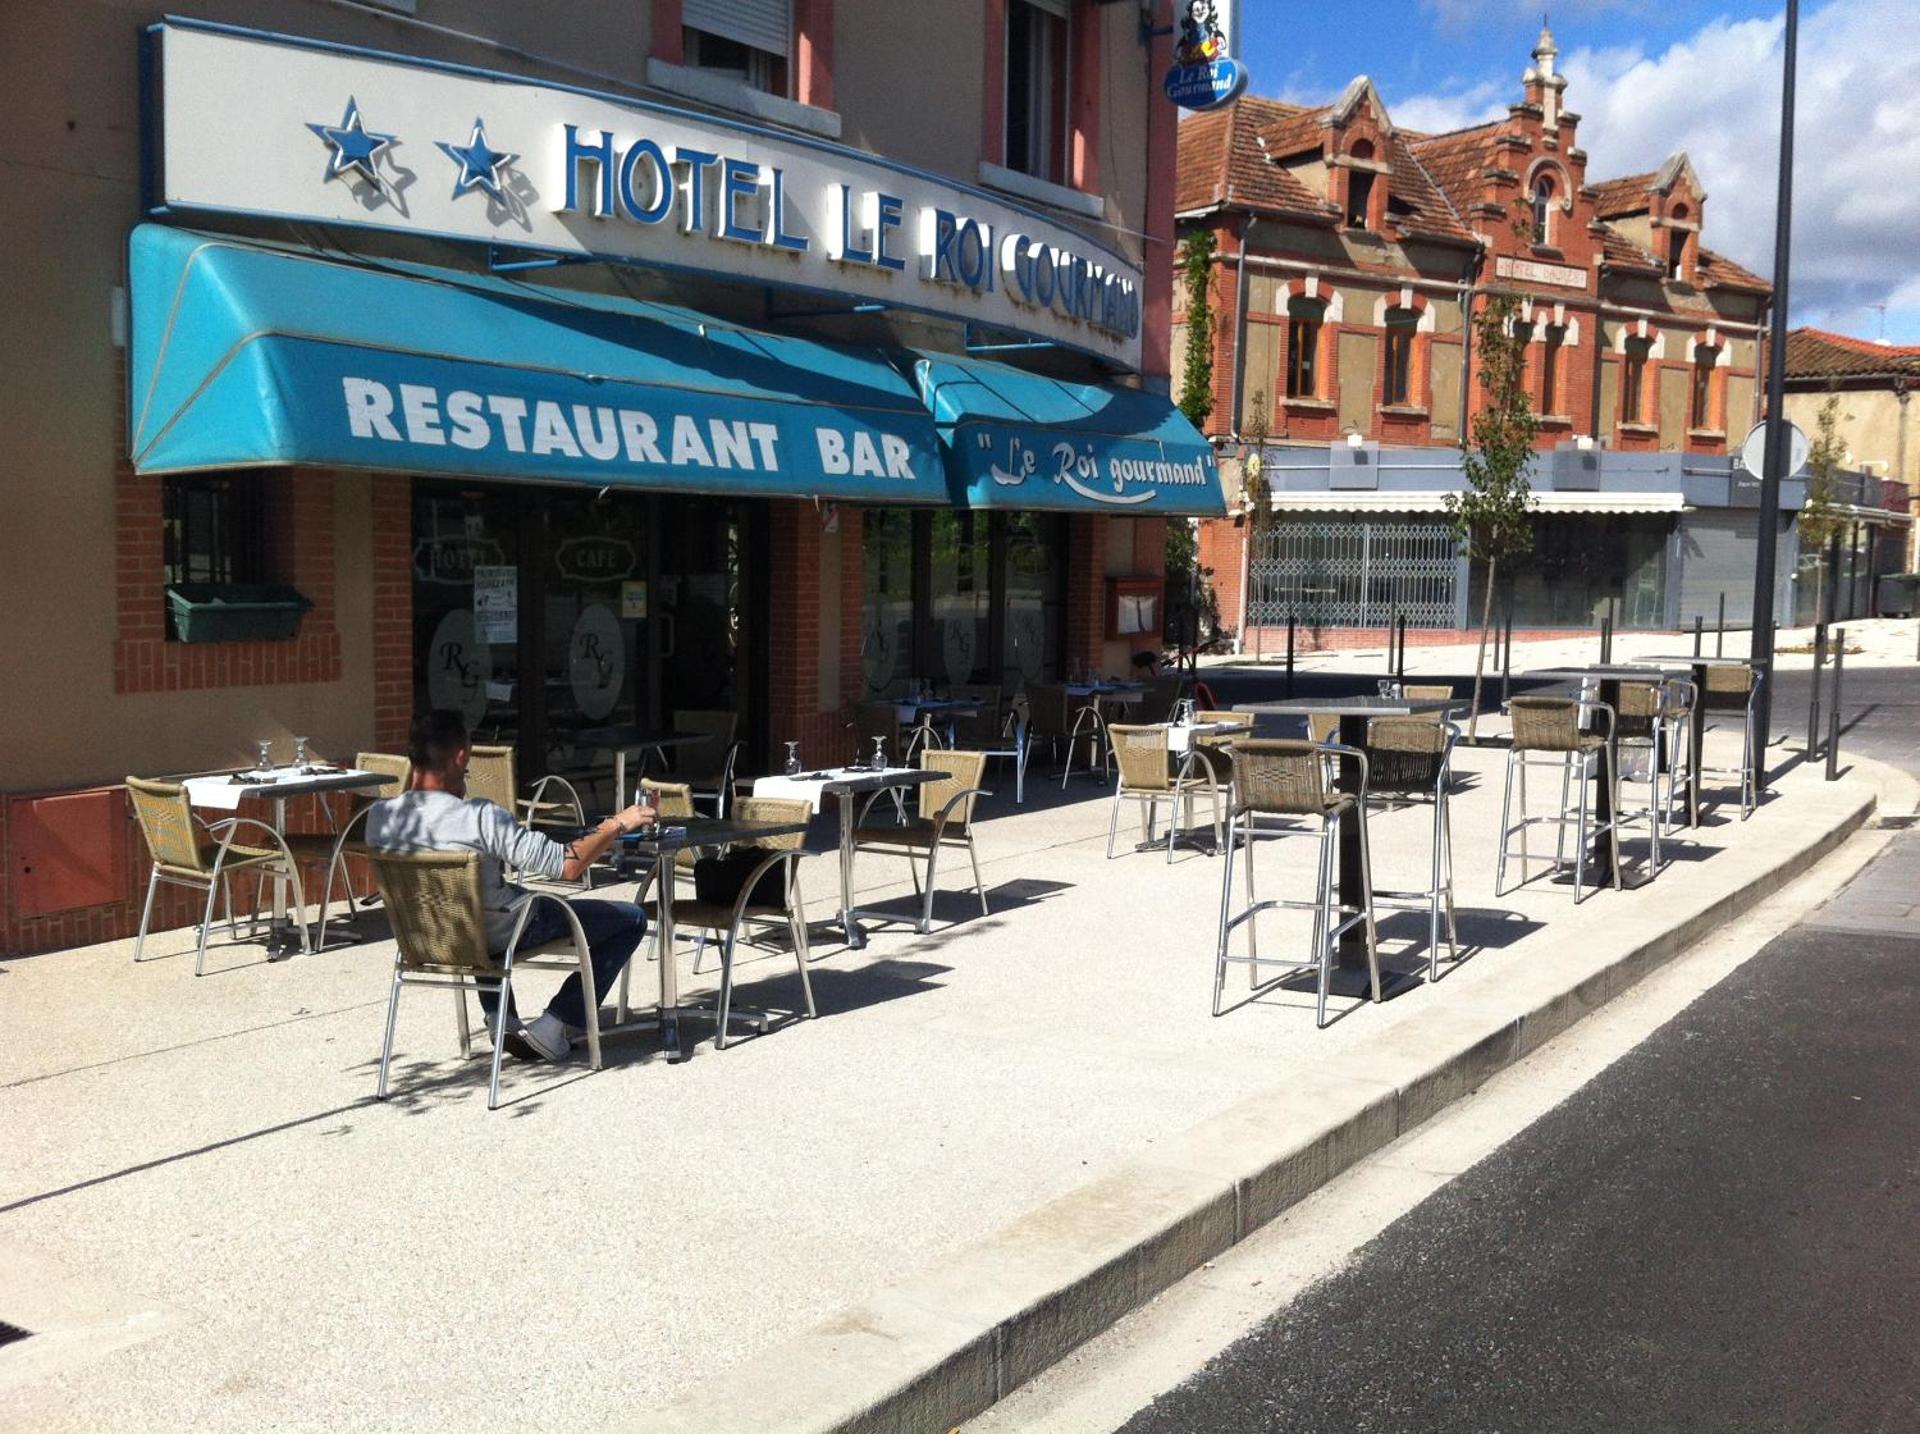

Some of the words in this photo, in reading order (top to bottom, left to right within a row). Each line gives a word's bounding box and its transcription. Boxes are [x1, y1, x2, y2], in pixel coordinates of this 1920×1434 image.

[1166, 74, 1233, 98] Gourmand
[1198, 63, 1219, 81] Roi
[562, 123, 810, 252] HOTEL
[836, 184, 906, 272] LE
[931, 208, 994, 293] ROI
[1008, 233, 1139, 340] GOURMAND
[341, 376, 778, 472] RESTAURANT
[815, 427, 916, 480] BAR
